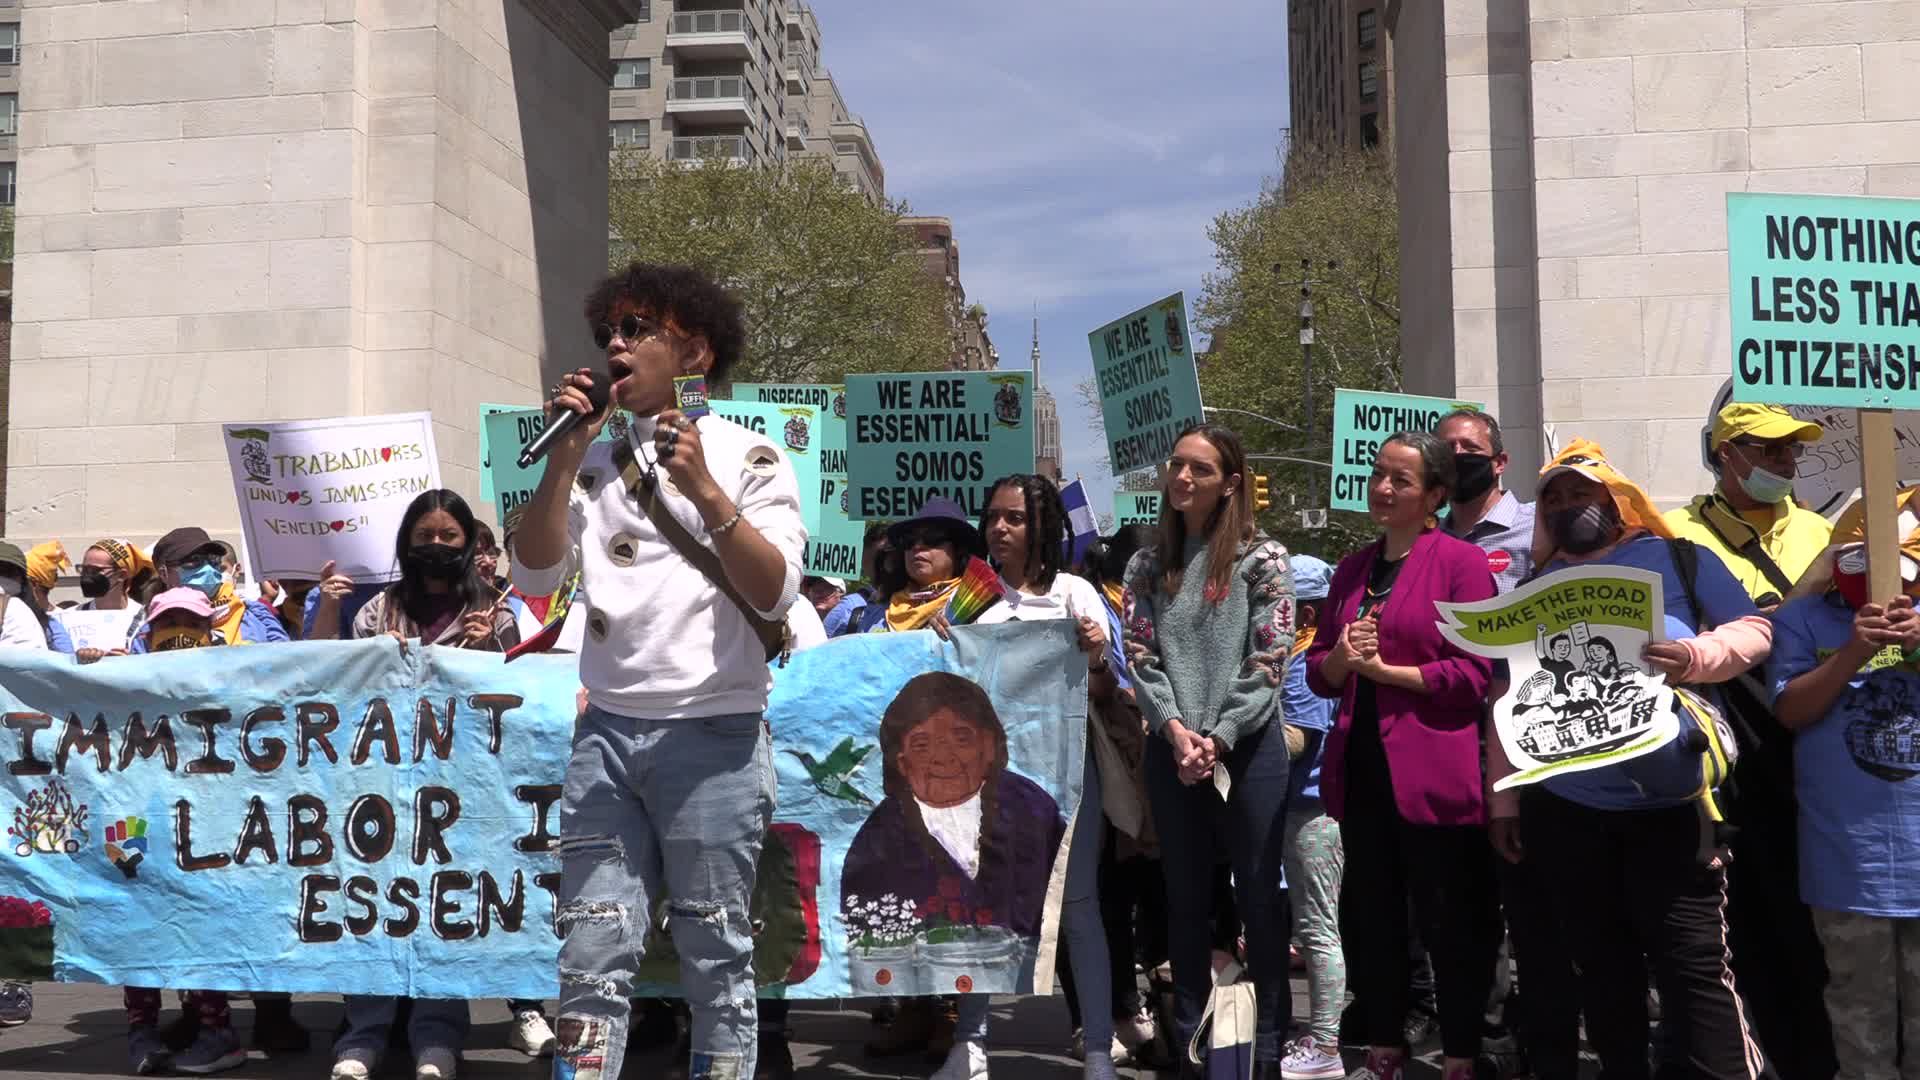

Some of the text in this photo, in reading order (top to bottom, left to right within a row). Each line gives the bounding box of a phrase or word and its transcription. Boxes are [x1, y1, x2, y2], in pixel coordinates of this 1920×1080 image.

[1766, 215, 1920, 266] NOTHING
[1751, 276, 1920, 327] LESS THA
[1103, 316, 1151, 361] WE ARE
[1100, 346, 1169, 398] ESSENTIAL!
[1739, 338, 1920, 391] CITIZENSH
[758, 387, 828, 412] DISREGARD
[877, 380, 966, 409] WE ARE
[1125, 387, 1172, 432] SOMOS
[857, 413, 990, 443] ESSENTIAL!
[1354, 404, 1440, 433] NOTHING
[895, 451, 984, 482] SOMOS
[1344, 439, 1378, 467] LES
[320, 482, 378, 504] JAMAS
[1135, 496, 1158, 515] WE
[812, 543, 857, 575] AHORA
[1477, 584, 1647, 634] MAKE THE ROAD
[1554, 604, 1645, 624] NEW YORK
[1, 693, 525, 777] IMMIGRANT
[175, 785, 461, 872] LABOR
[300, 867, 566, 943] ESSENT
